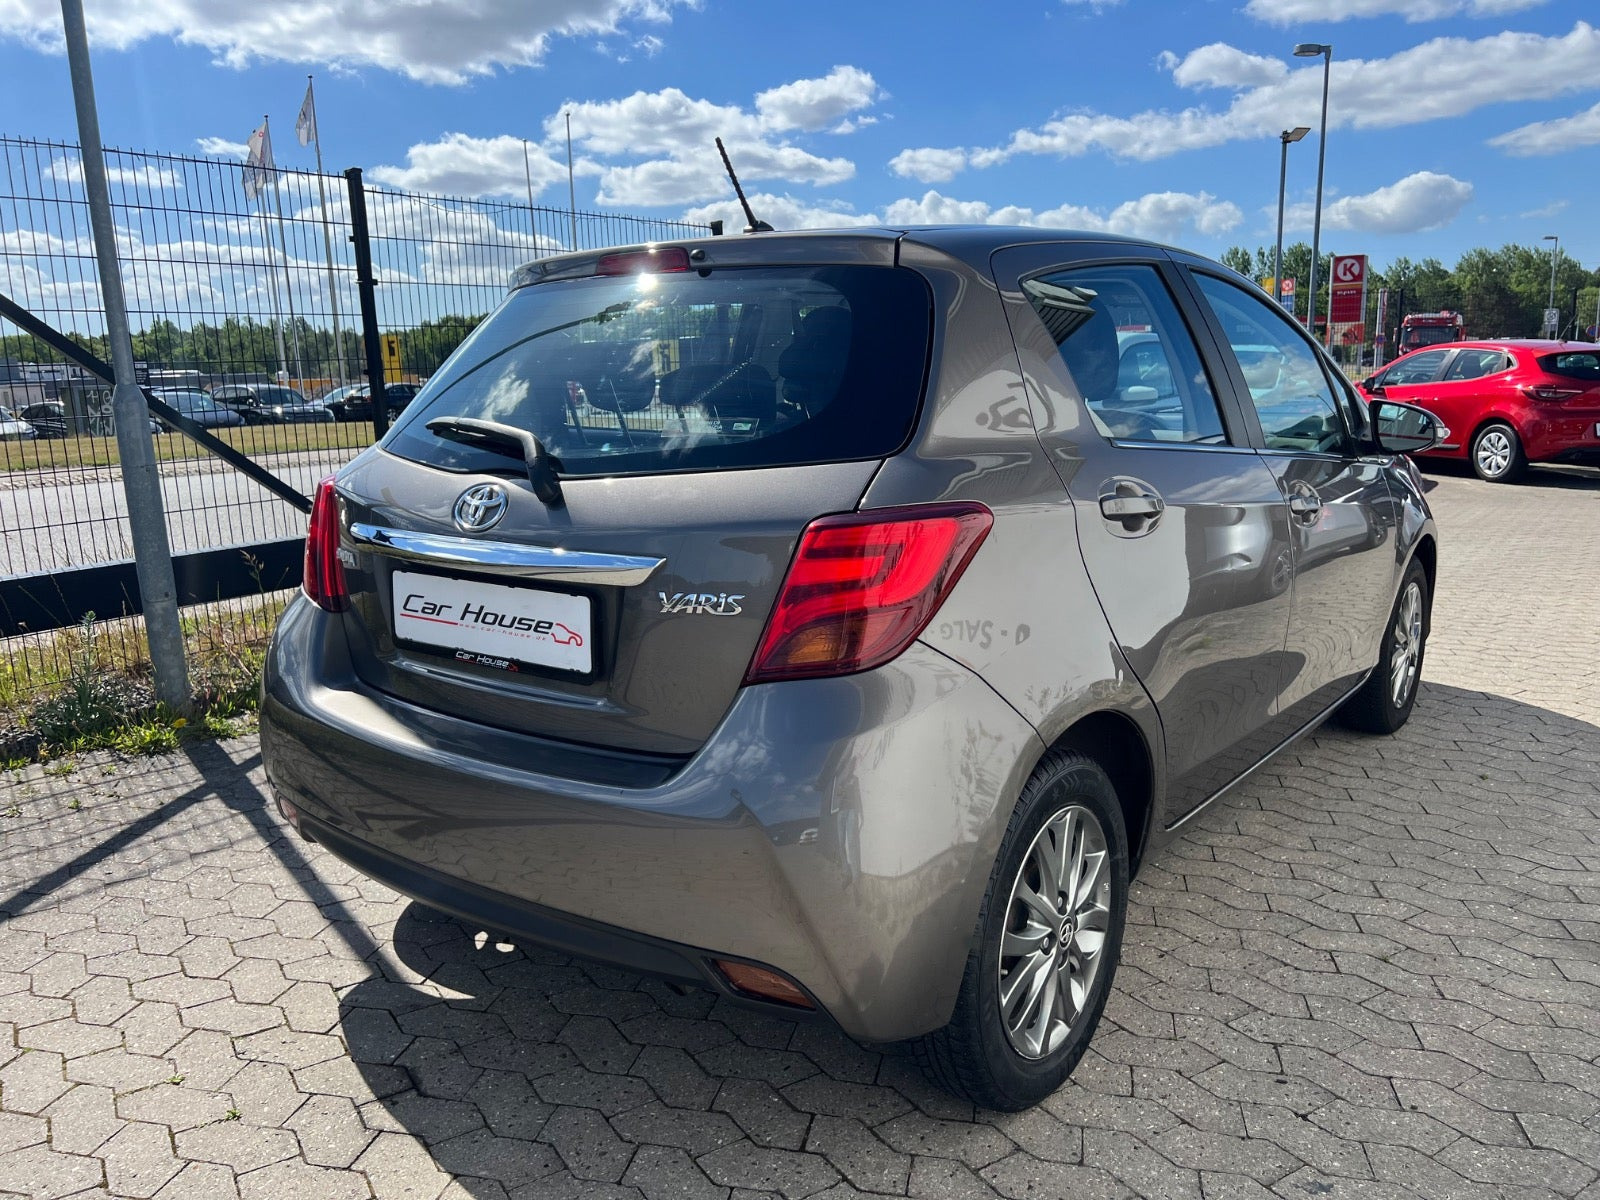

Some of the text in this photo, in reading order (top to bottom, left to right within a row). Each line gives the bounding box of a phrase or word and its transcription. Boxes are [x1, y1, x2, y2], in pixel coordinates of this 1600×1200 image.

[402, 593, 554, 635] Car House
[455, 650, 475, 660] Car
[476, 654, 510, 667] House
